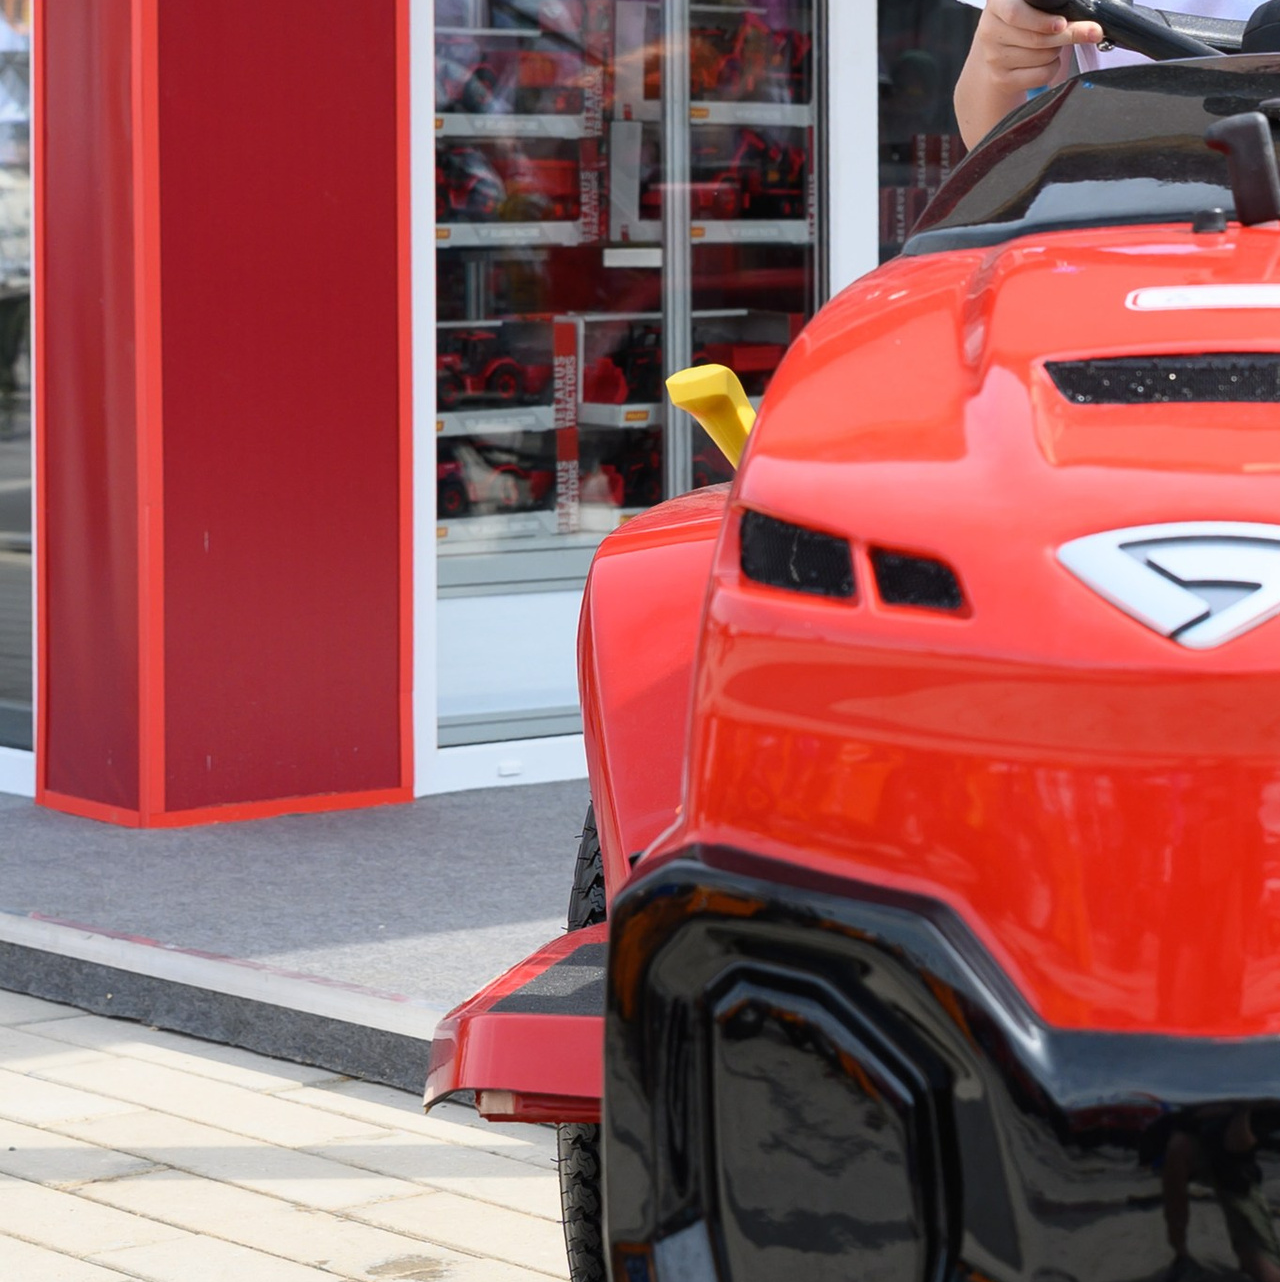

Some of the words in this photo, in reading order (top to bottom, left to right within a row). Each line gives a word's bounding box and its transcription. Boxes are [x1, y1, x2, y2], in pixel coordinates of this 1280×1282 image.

[554, 356, 566, 429] BELARUS
[565, 356, 576, 428] TRACTORS
[556, 461, 569, 533] BELARUS
[568, 460, 579, 532] TRACTORS
